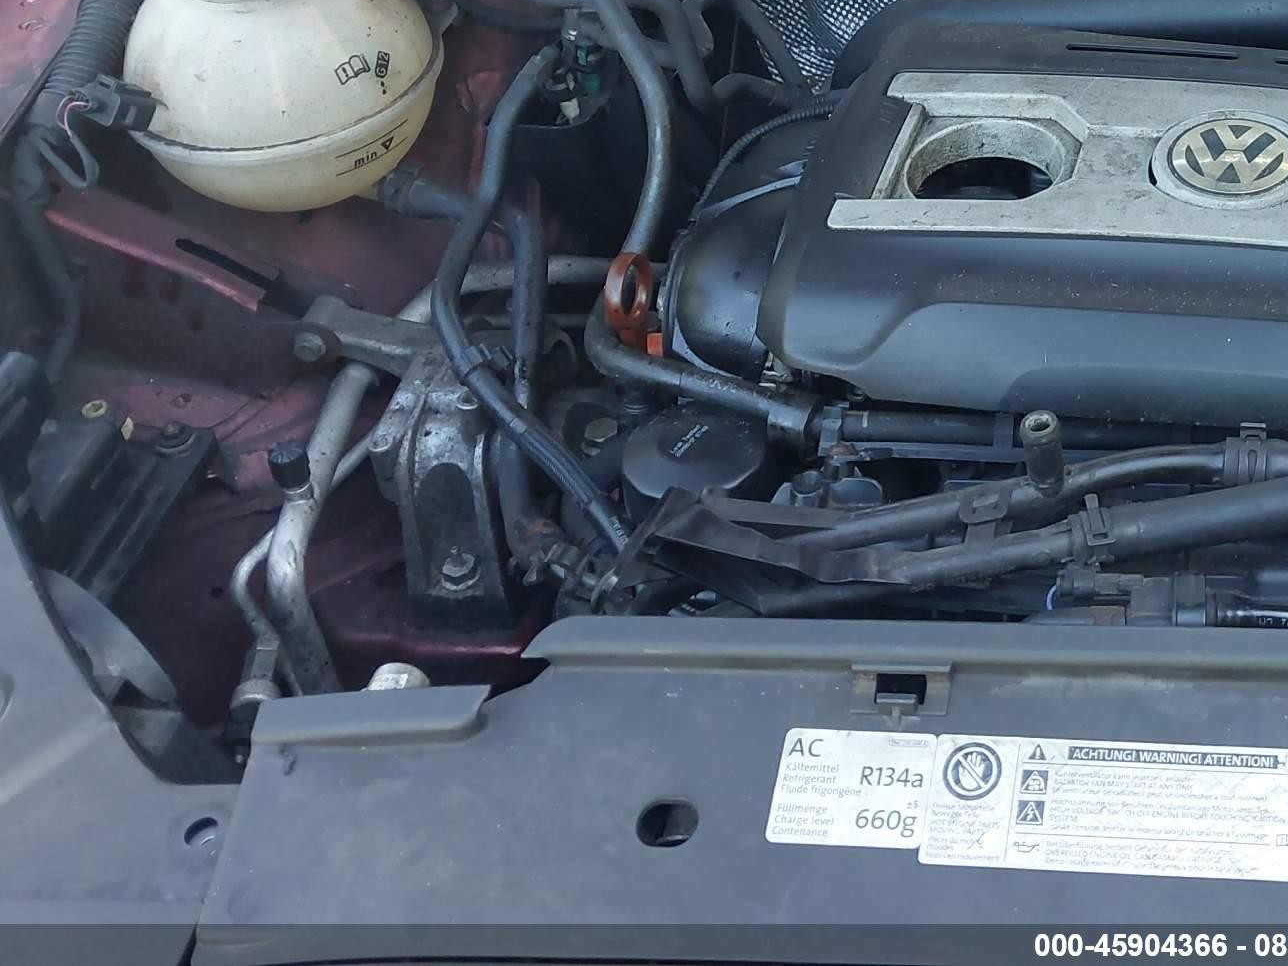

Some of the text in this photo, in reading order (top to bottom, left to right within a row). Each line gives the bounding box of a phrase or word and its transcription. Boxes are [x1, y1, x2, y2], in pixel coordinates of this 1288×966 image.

[353, 151, 378, 169] min
[788, 737, 824, 758] AC
[1139, 750, 1202, 765] WARNING!
[1203, 754, 1274, 768] ATTENTION!
[785, 763, 840, 774] Kältemittel
[859, 766, 924, 788] R134a
[782, 774, 837, 785] Refrigerant
[774, 815, 808, 826] Charge
[855, 808, 918, 838] 660g
